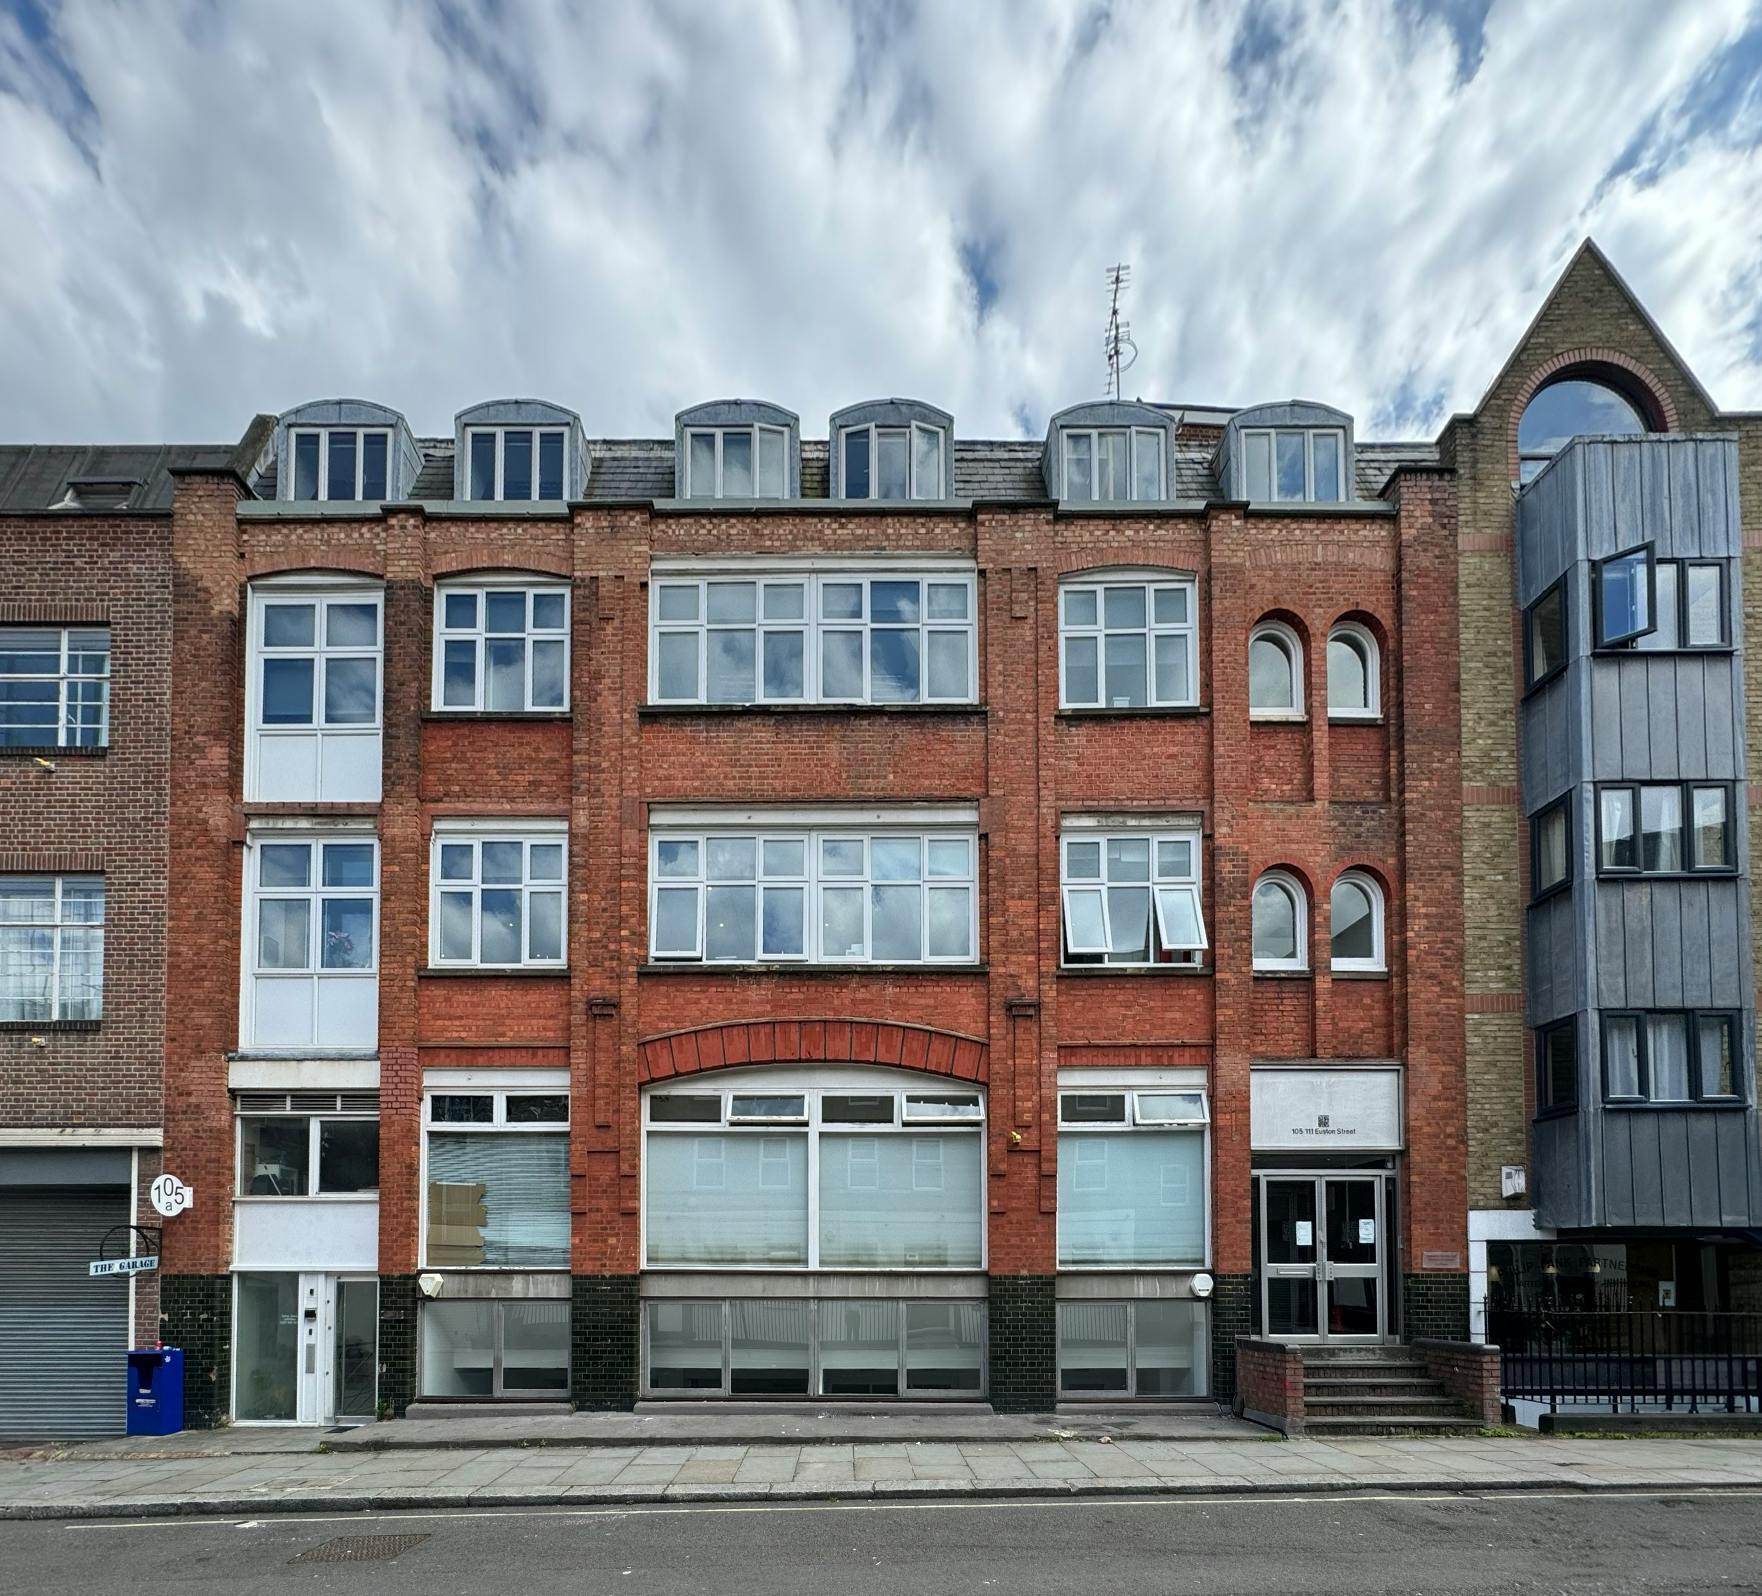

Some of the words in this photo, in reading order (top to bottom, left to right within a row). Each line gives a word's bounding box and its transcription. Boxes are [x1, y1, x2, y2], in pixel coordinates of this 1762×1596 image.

[1314, 1127, 1336, 1135] Euston
[1336, 1127, 1356, 1135] Street
[154, 1177, 185, 1205] 105
[165, 1201, 173, 1211] a
[93, 1263, 114, 1273] THE
[119, 1259, 156, 1271] GARAGE
